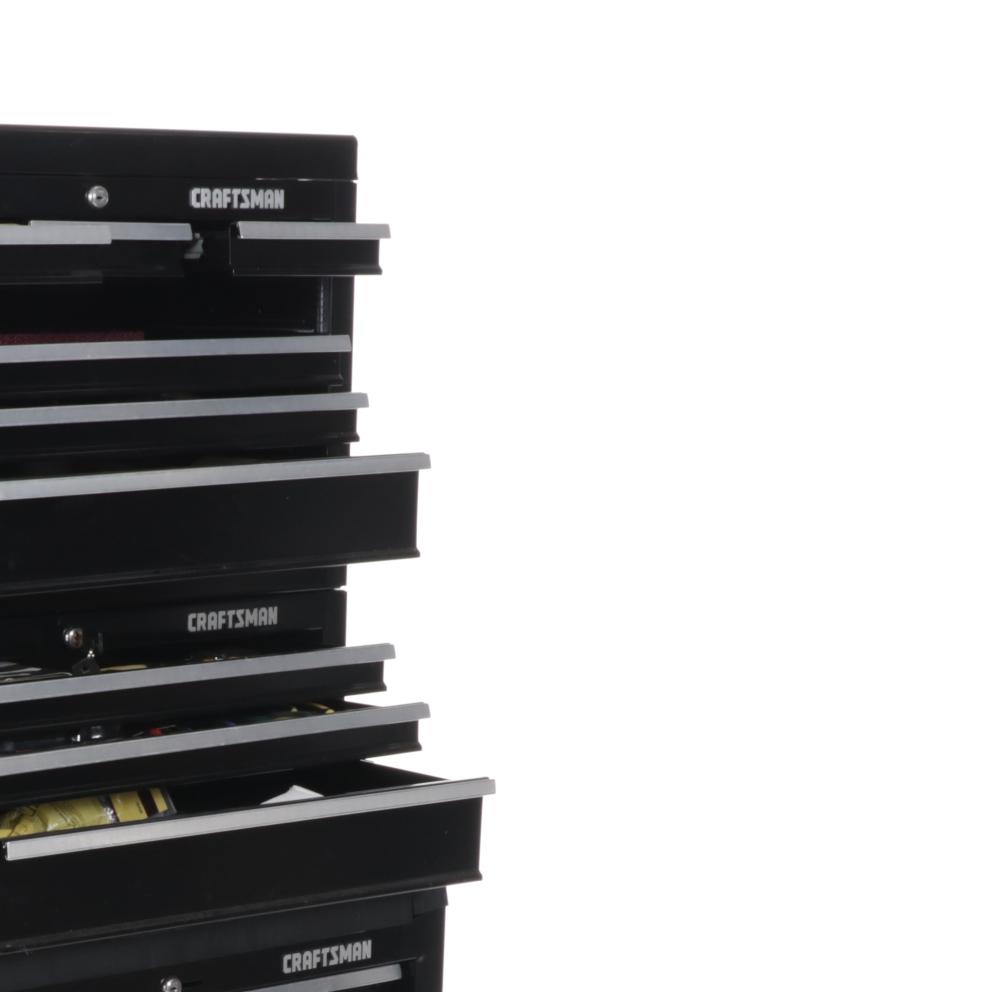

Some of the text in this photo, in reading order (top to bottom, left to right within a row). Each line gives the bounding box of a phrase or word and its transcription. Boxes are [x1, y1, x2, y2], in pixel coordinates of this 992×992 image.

[190, 187, 285, 210] CRAFTSMAN
[187, 606, 278, 632] CRAFTSMAN
[282, 939, 372, 974] CRAFTSMAN
